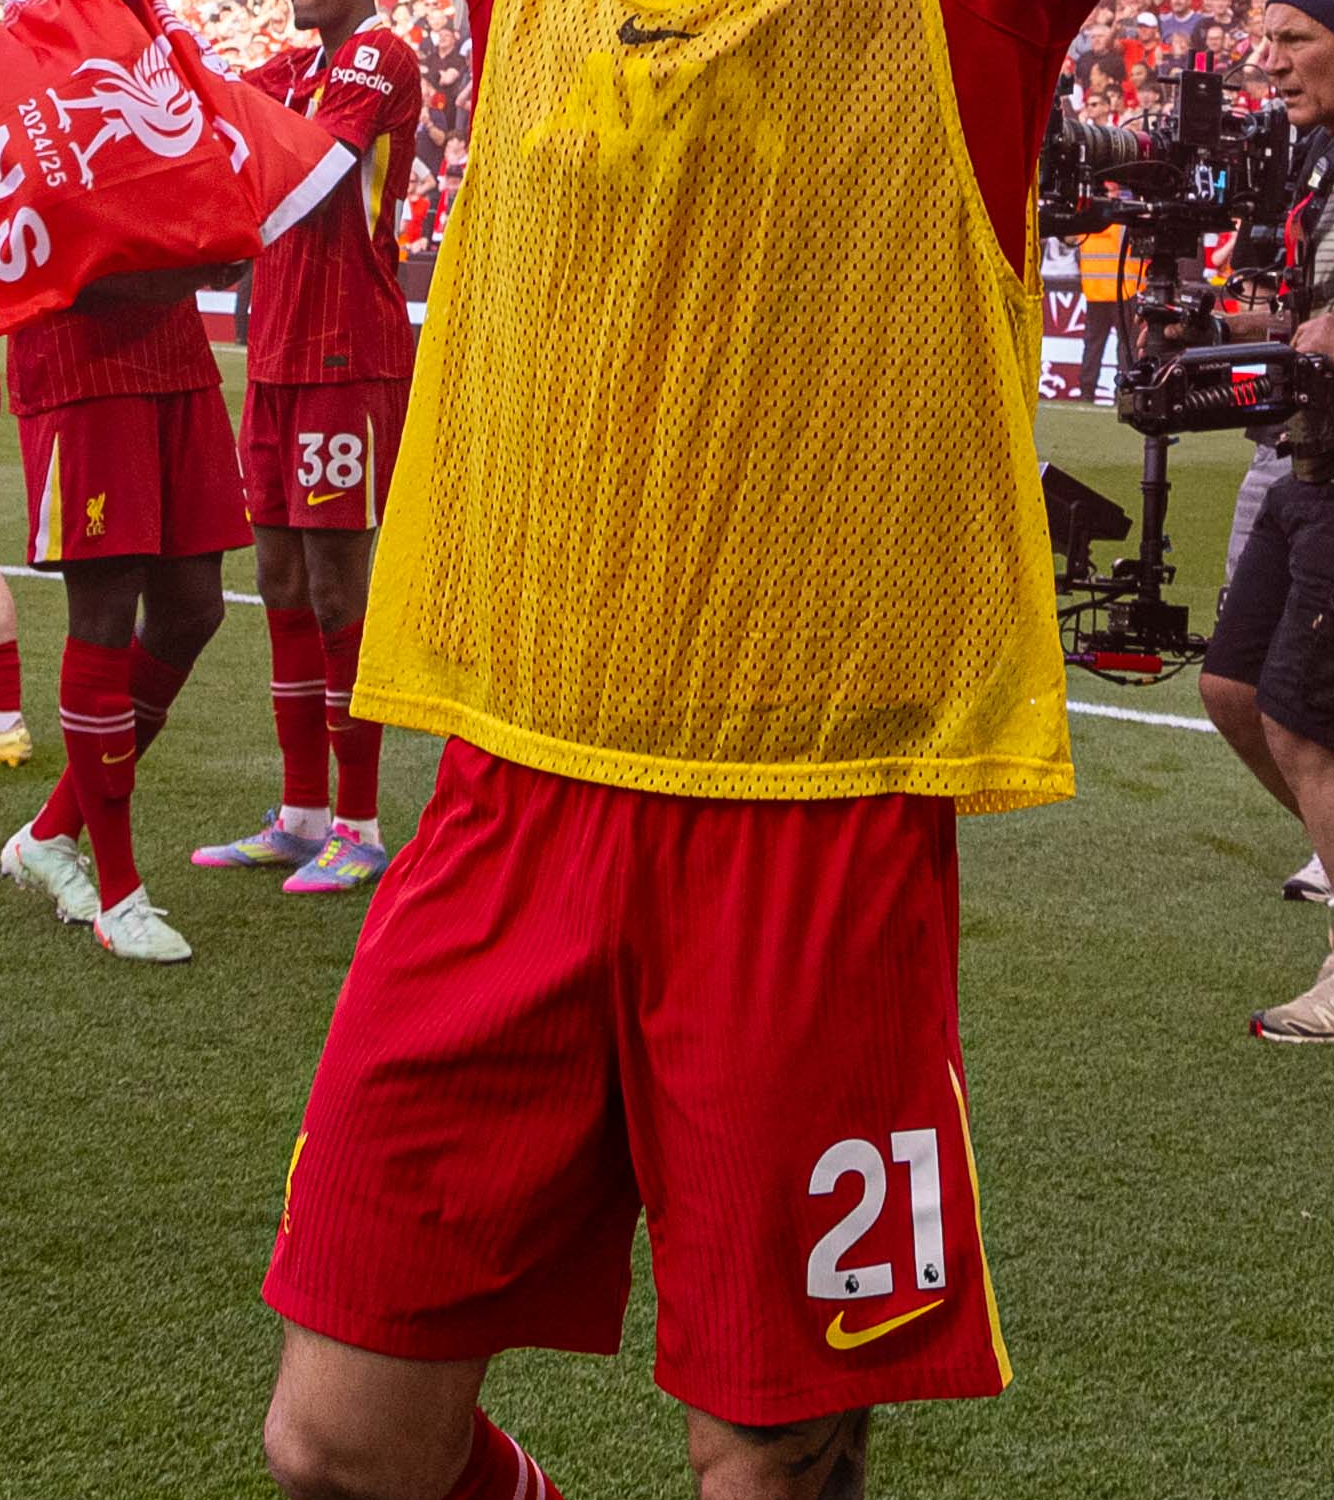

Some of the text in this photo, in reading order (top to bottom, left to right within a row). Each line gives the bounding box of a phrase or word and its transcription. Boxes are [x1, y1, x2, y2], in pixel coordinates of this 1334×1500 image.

[18, 98, 67, 188] 2024/25
[297, 432, 363, 488] 38
[807, 1127, 946, 1299] 21
